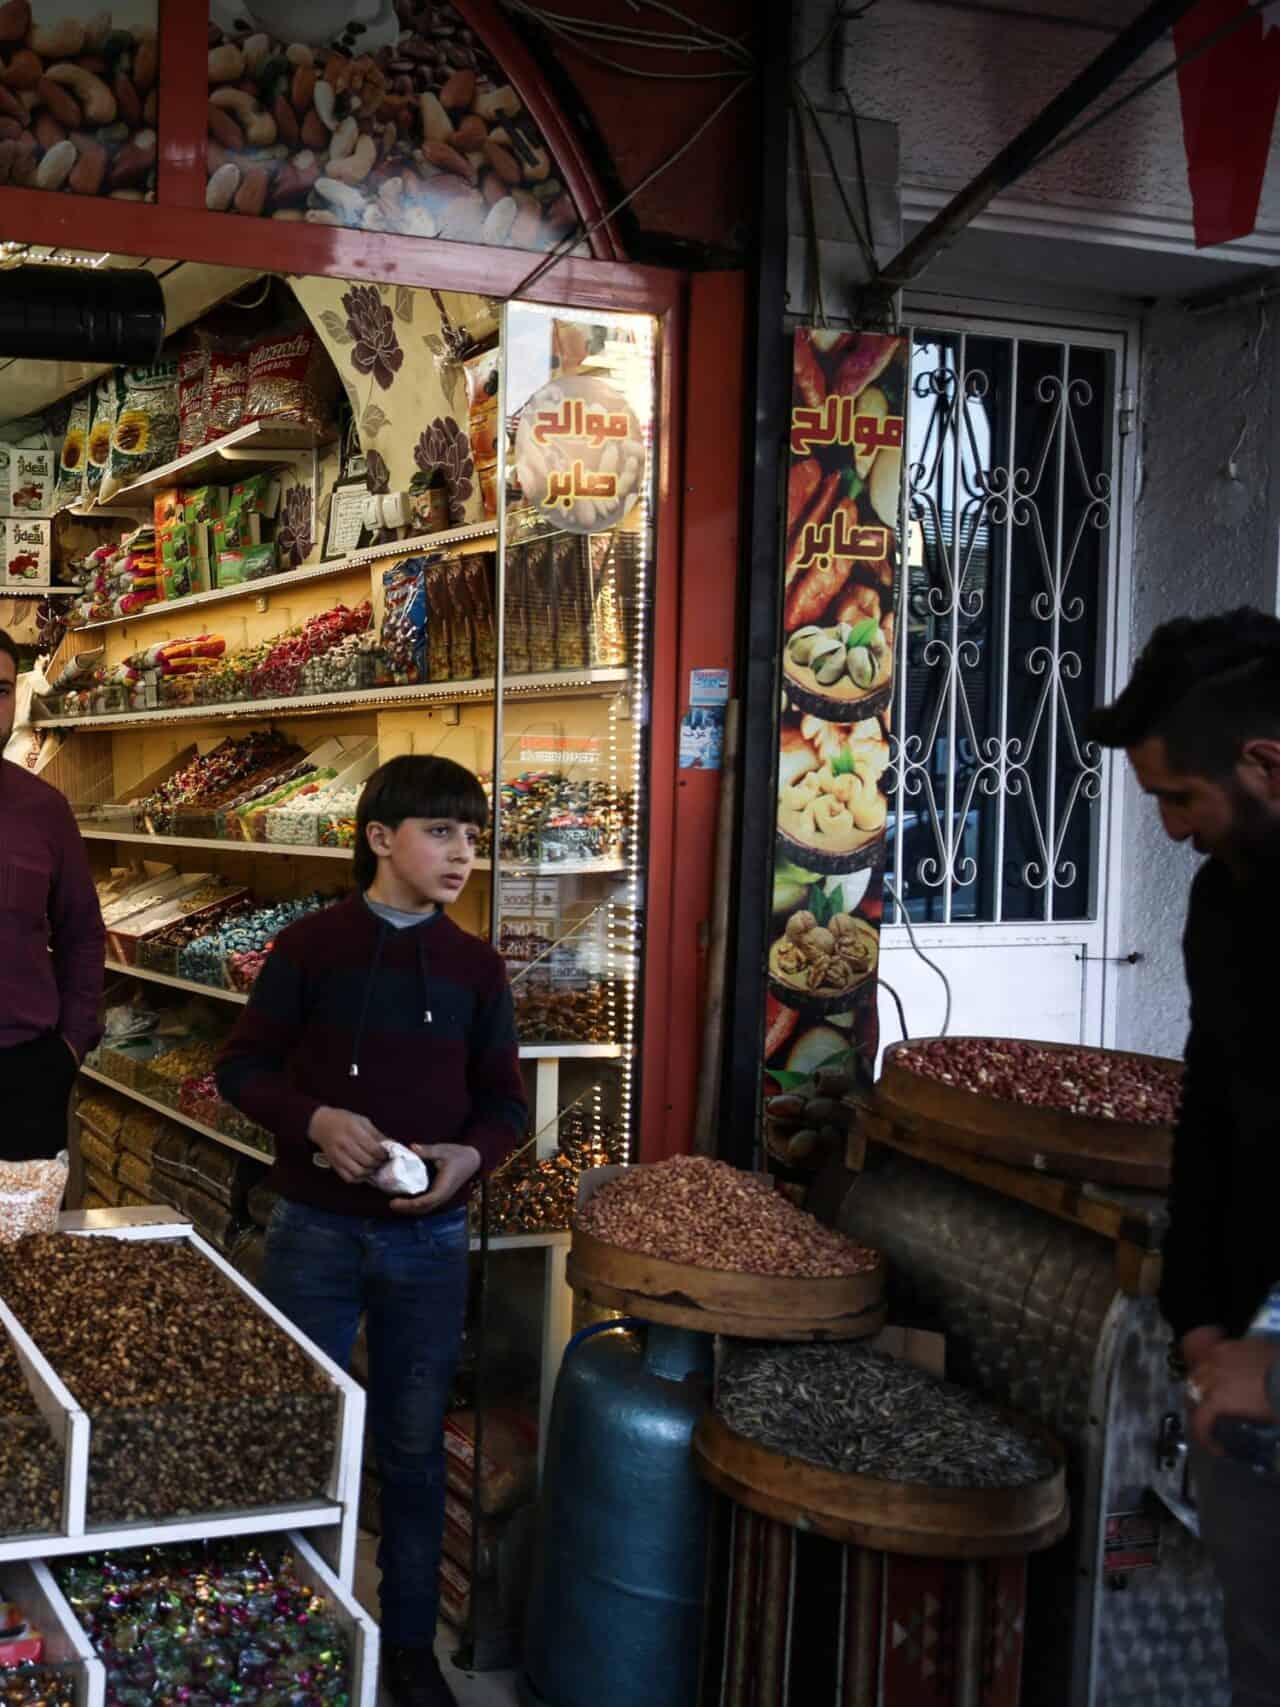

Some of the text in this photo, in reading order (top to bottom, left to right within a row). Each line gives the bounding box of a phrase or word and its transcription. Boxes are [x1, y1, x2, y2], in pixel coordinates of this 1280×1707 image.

[533, 398, 630, 448] موالح
[790, 394, 905, 459] موالح
[541, 459, 618, 510] صابر
[793, 508, 889, 570] صابر
